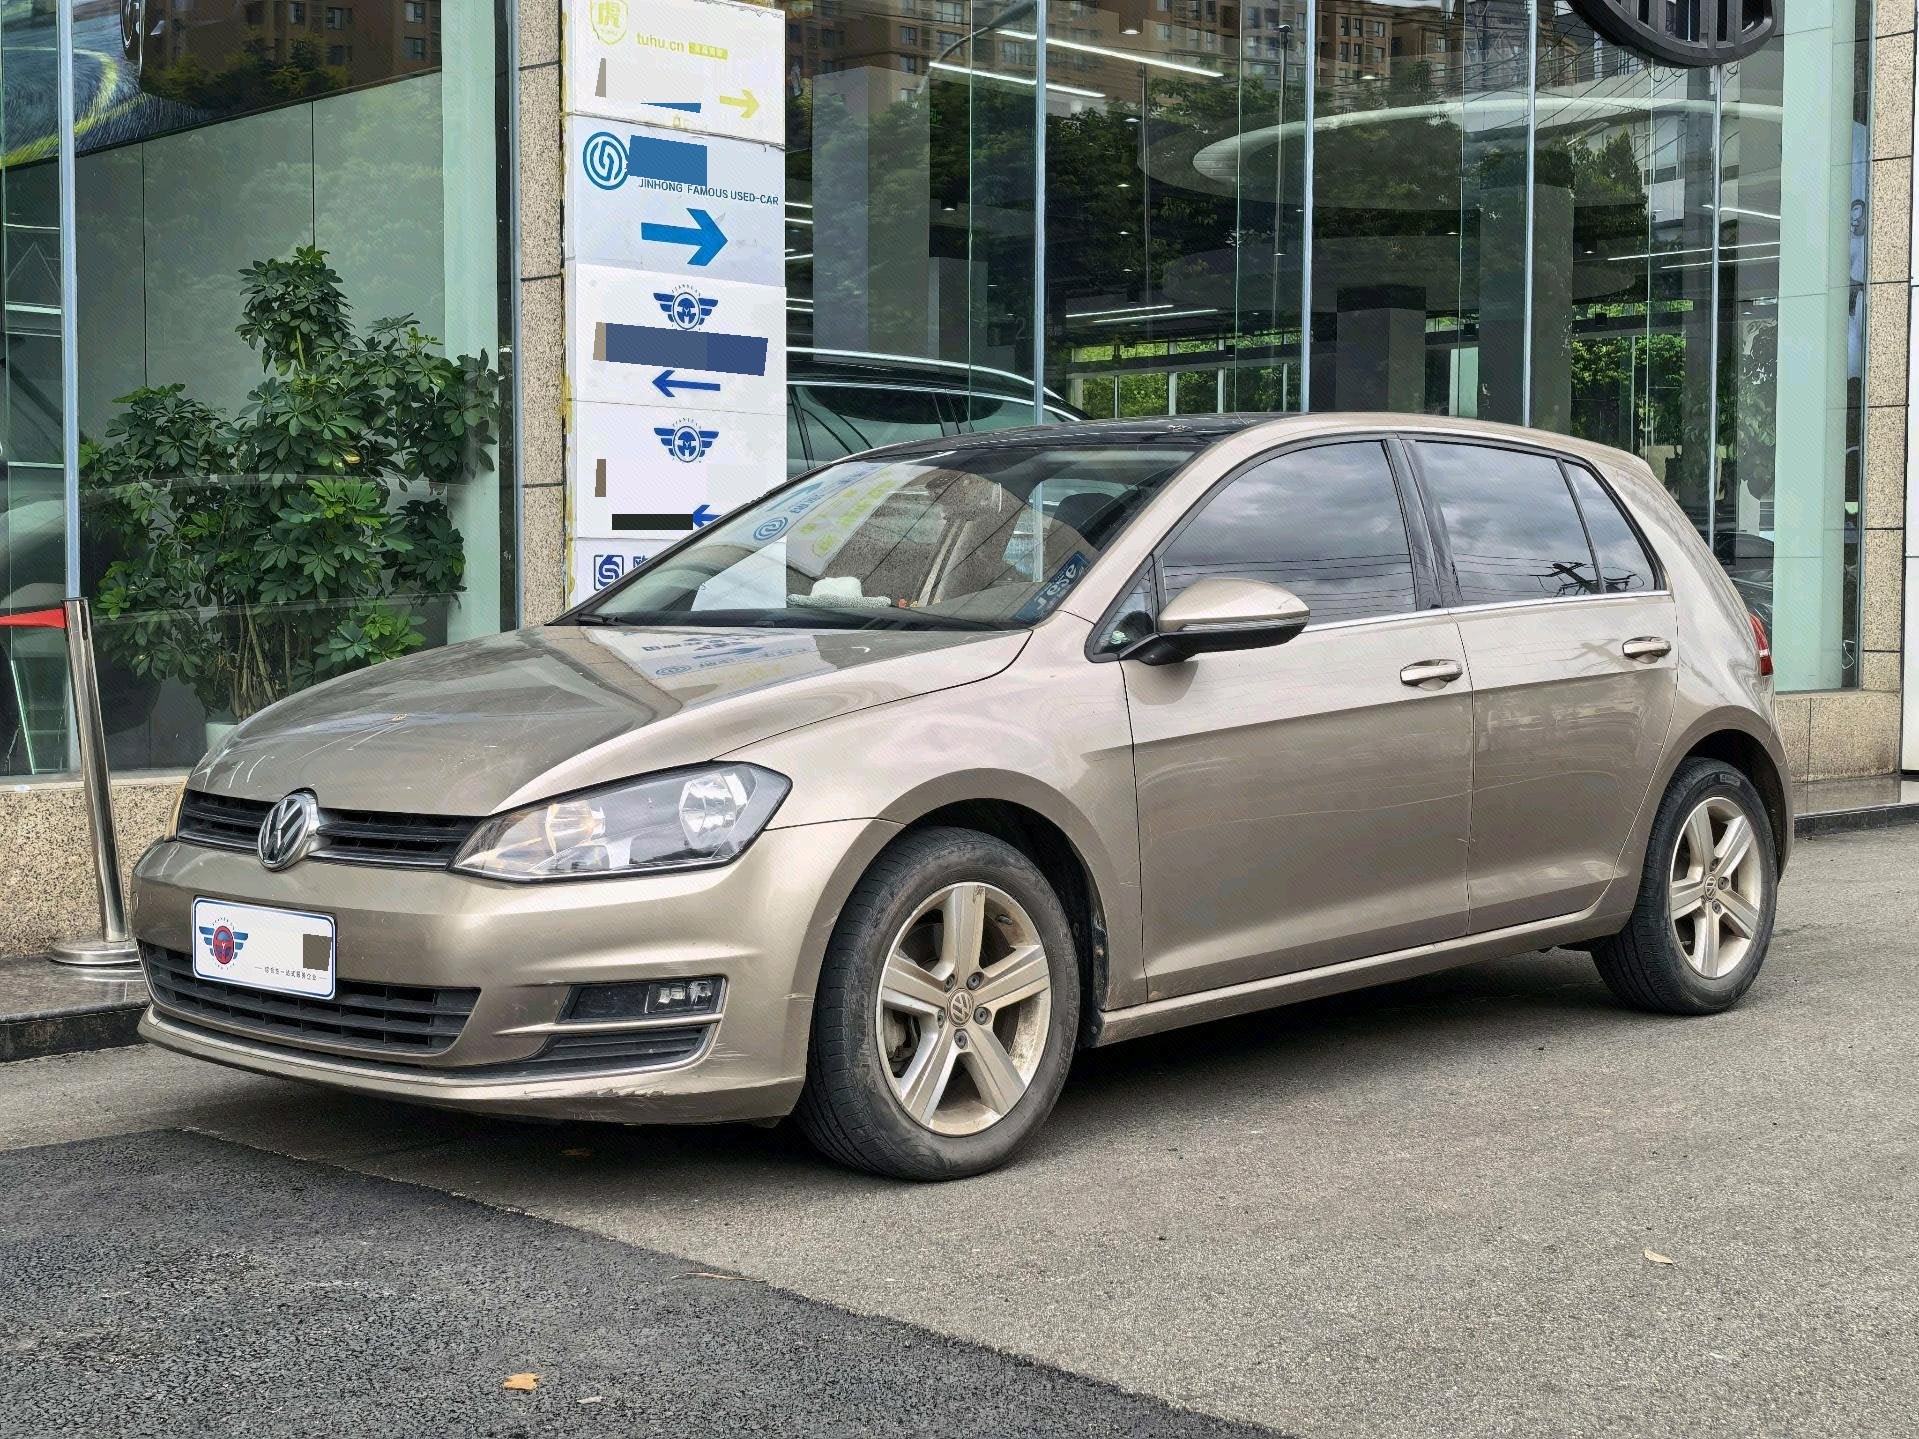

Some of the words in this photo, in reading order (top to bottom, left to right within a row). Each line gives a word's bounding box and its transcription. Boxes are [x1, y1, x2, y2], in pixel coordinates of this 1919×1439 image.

[637, 32, 684, 52] tuhu.cn
[639, 178, 683, 193] JINHONG
[687, 184, 728, 199] FAMOUS
[730, 190, 779, 206] USED-CAR
